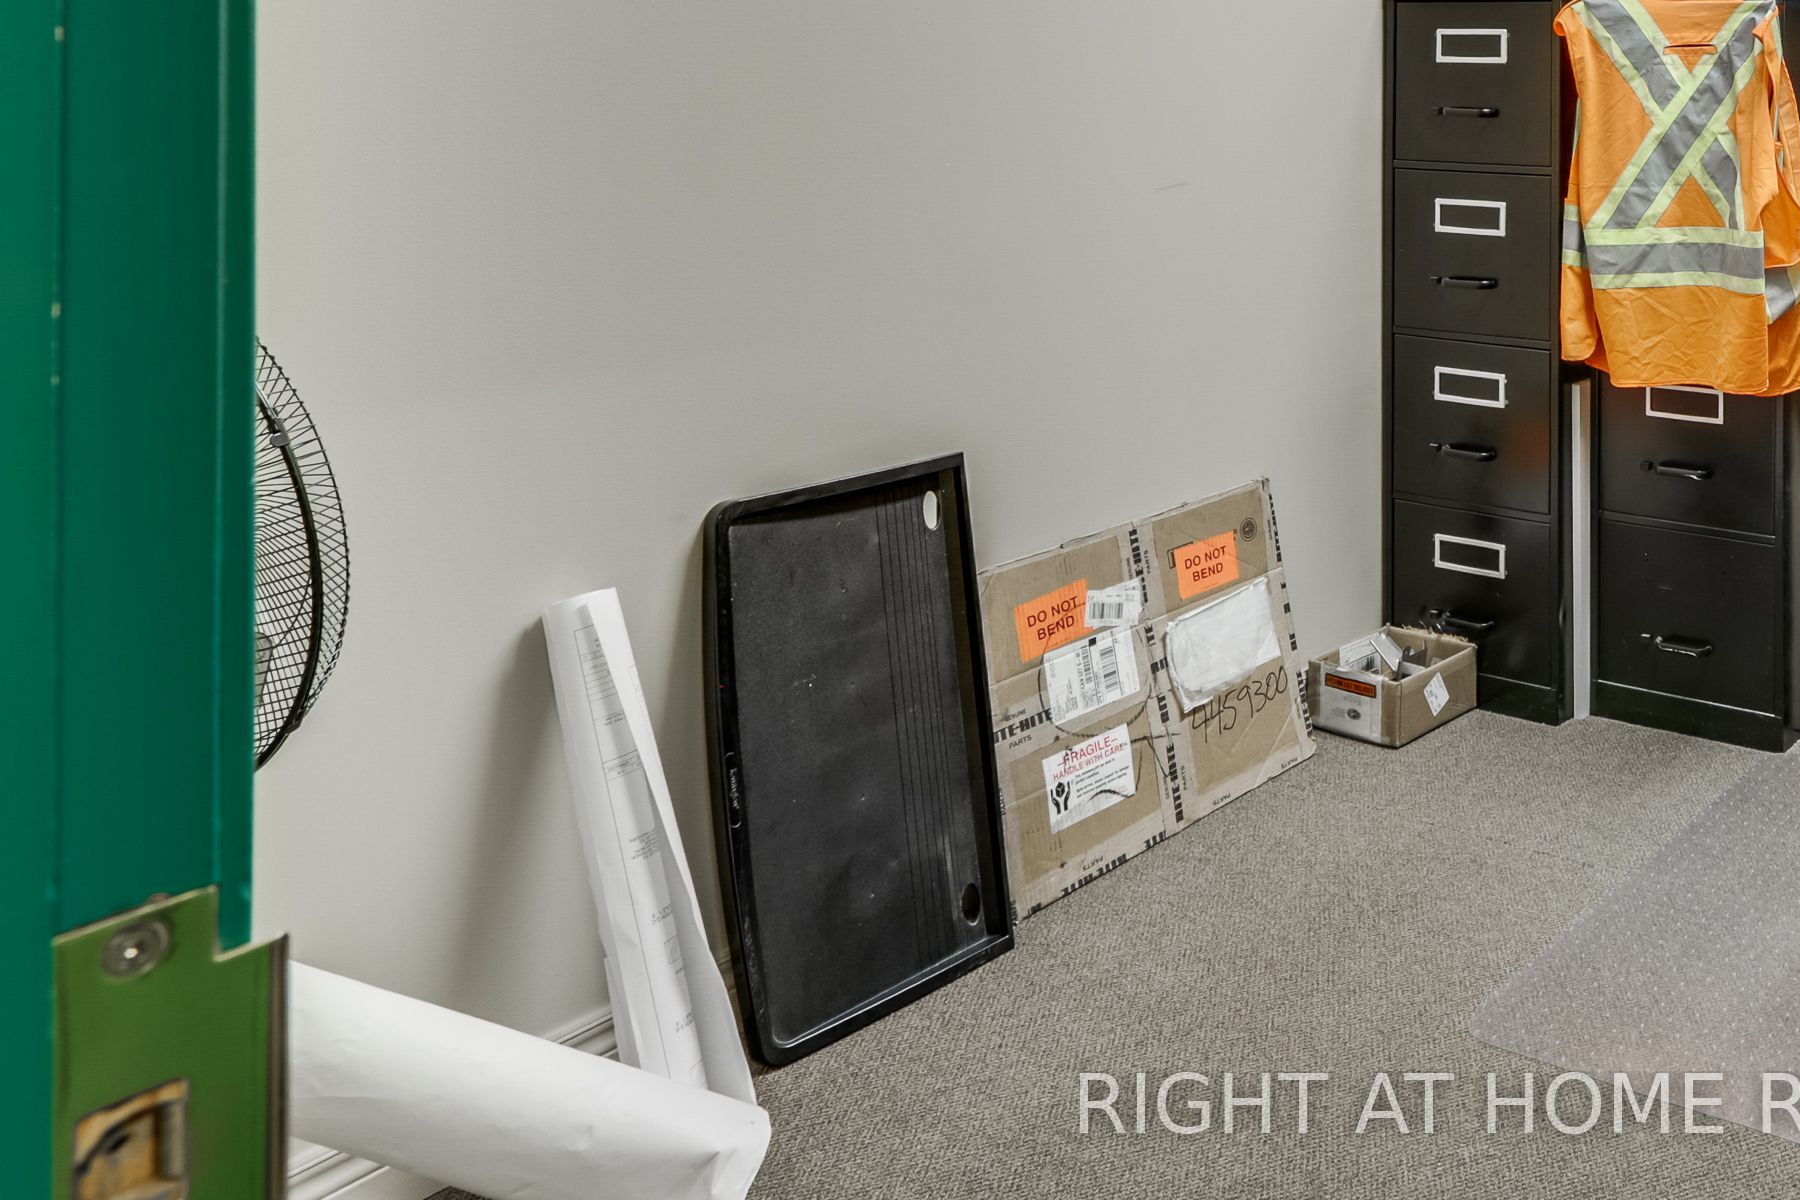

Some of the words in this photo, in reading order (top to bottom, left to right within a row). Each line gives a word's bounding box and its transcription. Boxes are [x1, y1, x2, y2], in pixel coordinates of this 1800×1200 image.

[1143, 549, 1151, 575] PARTS
[1184, 554, 1201, 570] DO
[1204, 545, 1226, 563] NOT
[1192, 562, 1224, 582] BEND
[1026, 609, 1047, 628] DO
[1051, 595, 1078, 615] NOT
[1036, 615, 1075, 641] BEND
[1191, 665, 1288, 744] 4459300
[993, 708, 1052, 744] ITE-HITE
[1008, 734, 1033, 750] PARTS
[1061, 736, 1114, 766] FRAGILE
[1052, 761, 1084, 782] HANDLE
[1084, 752, 1104, 769] WITH
[1103, 743, 1125, 761] CARE
[1165, 742, 1185, 824] RITE-HITE
[1180, 764, 1188, 791] PARTS
[1082, 855, 1104, 872] PARTS
